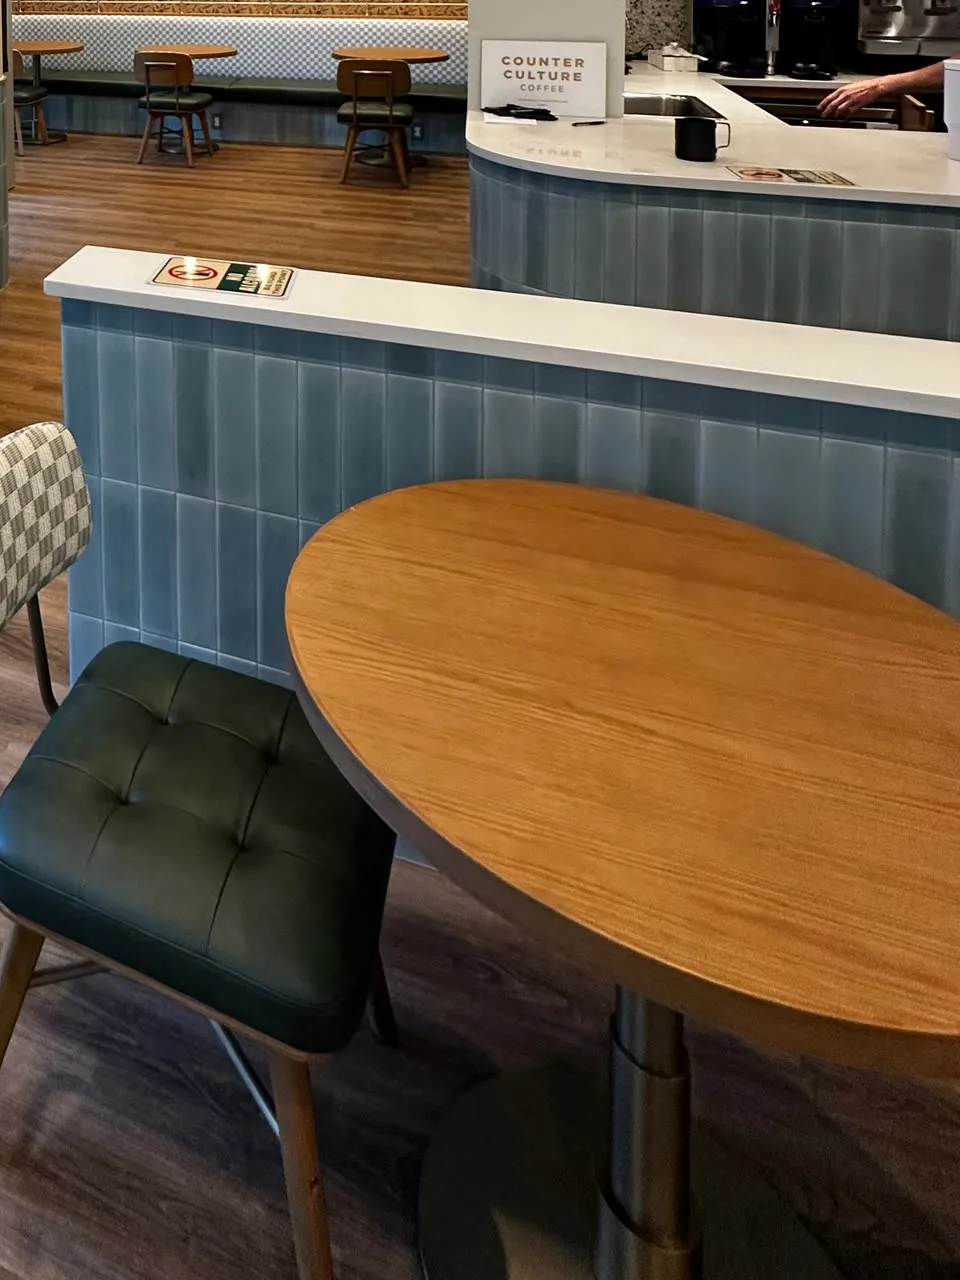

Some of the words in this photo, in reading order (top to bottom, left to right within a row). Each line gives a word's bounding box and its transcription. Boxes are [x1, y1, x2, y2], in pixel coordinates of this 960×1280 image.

[501, 56, 585, 68] COUNTER
[503, 70, 582, 81] CULTURE
[520, 84, 564, 93] COFFEE
